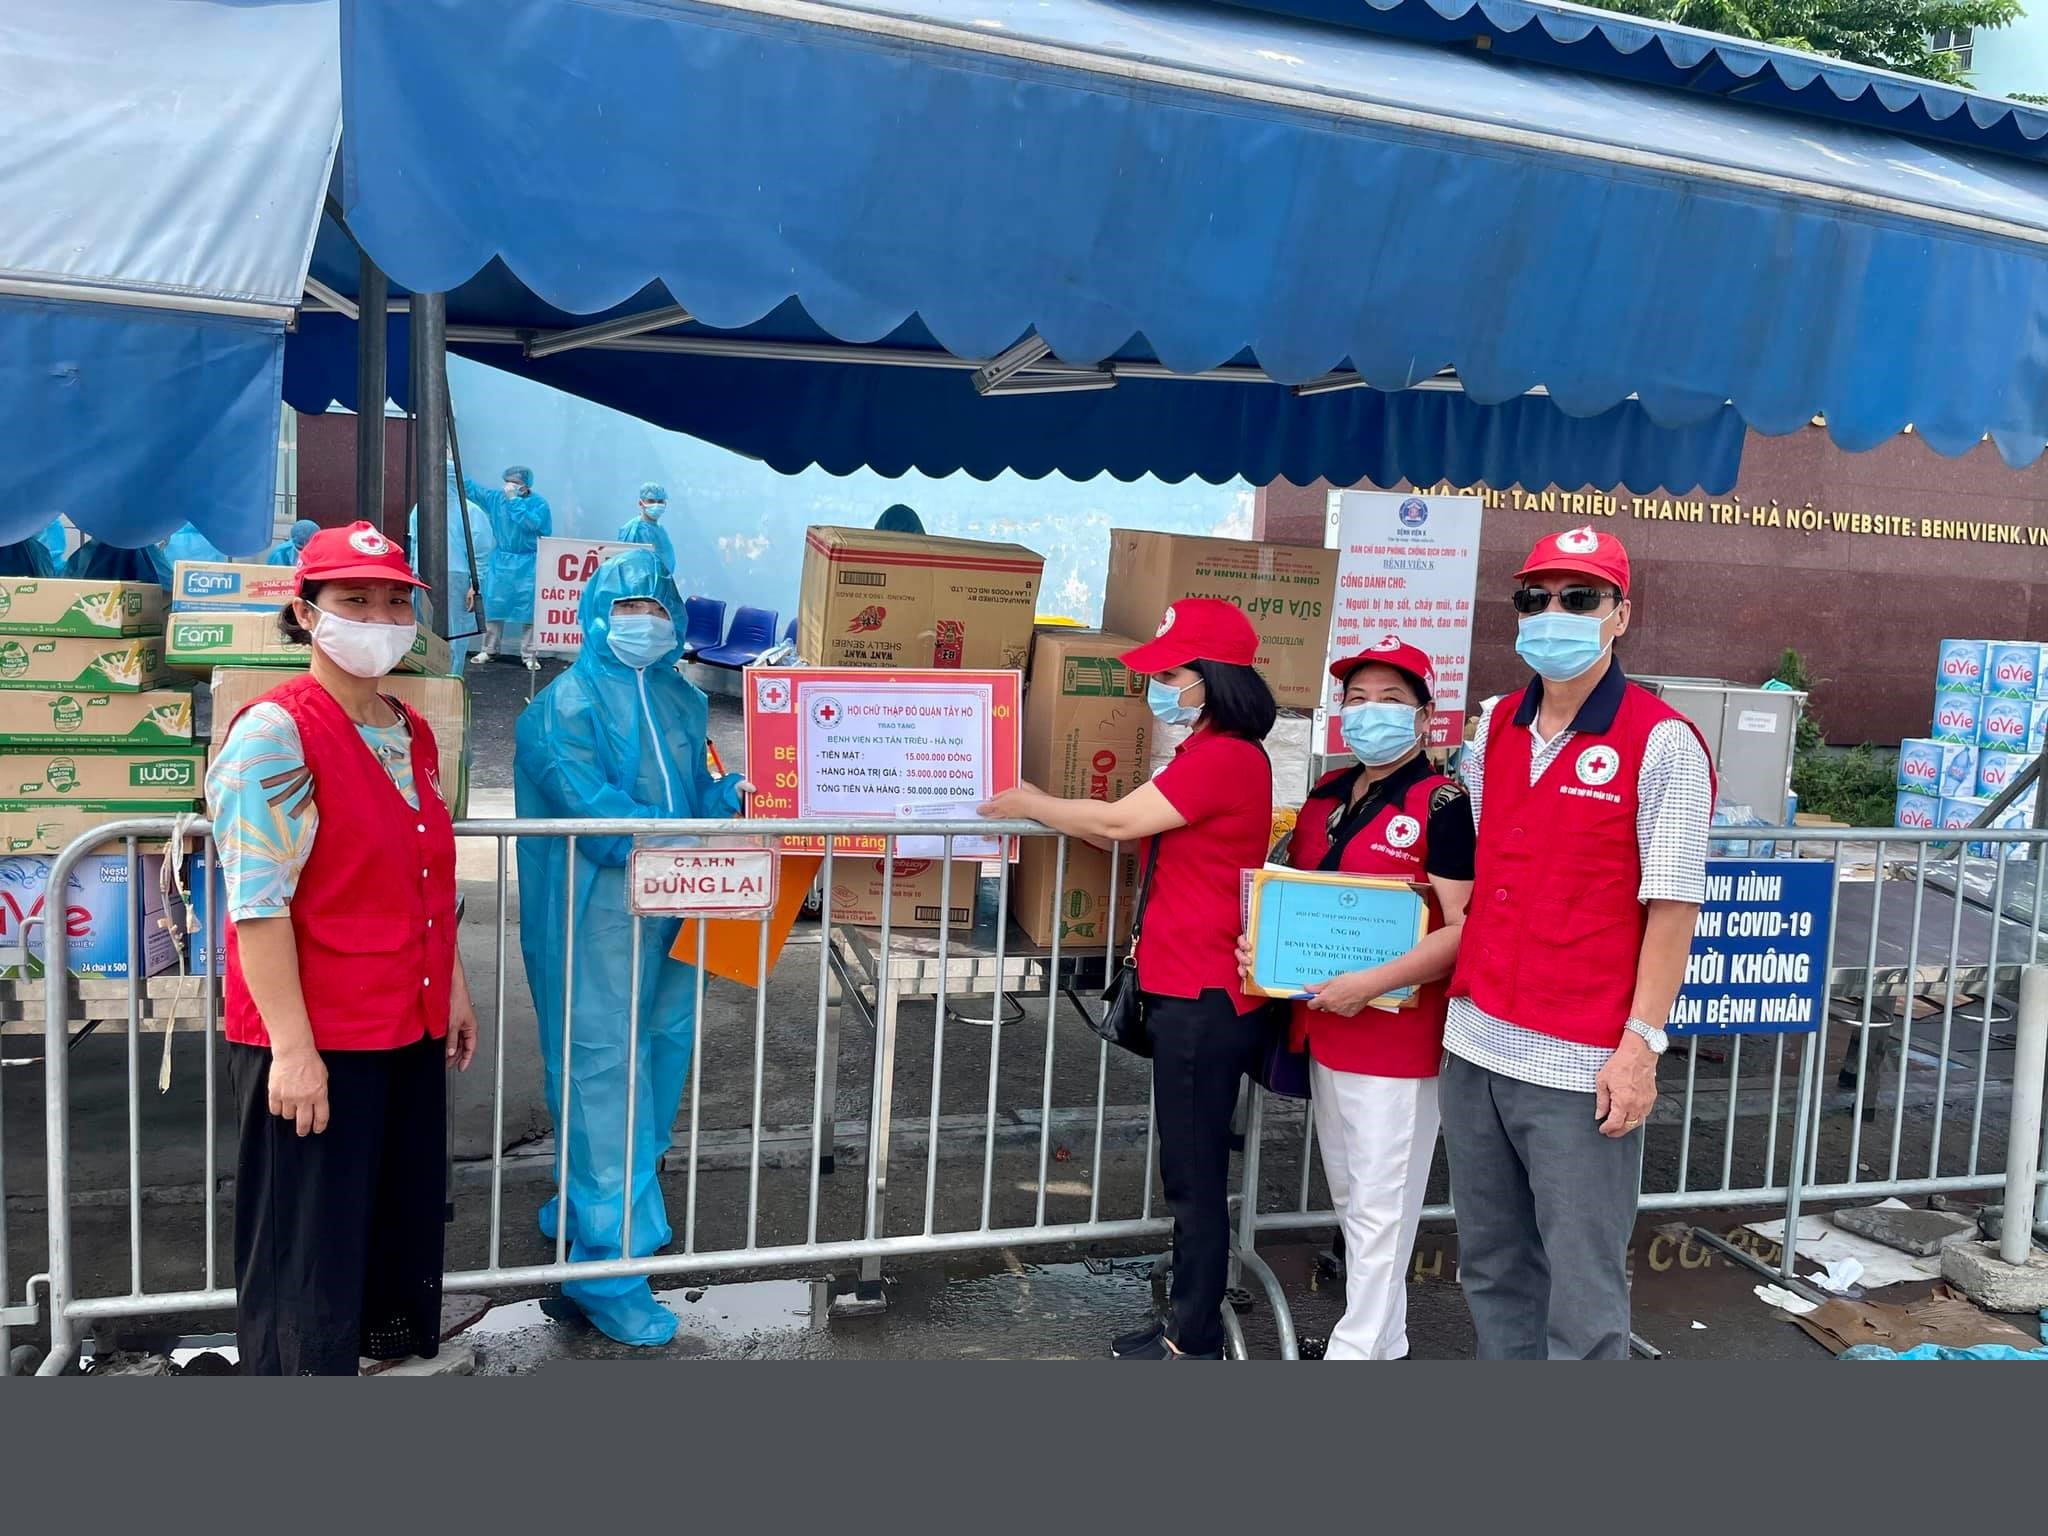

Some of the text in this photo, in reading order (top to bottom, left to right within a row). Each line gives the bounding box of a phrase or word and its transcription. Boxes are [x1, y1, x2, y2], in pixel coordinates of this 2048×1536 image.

[1631, 497, 1703, 523] THANH
[1921, 518, 2048, 546] BENHVIENK.VN
[1429, 561, 1435, 570] K
[188, 572, 232, 589] Fami
[1388, 576, 1406, 589] CHO:
[1247, 597, 1283, 621] BẮP
[1289, 600, 1322, 621] SỮA
[1345, 598, 1369, 611] Người
[1384, 600, 1393, 610] ho
[1456, 600, 1469, 610] đau
[1437, 616, 1451, 628] đau
[177, 626, 224, 643] Fami
[540, 632, 558, 646] TẠI
[832, 639, 902, 650] SHELLY SENBEI
[844, 650, 893, 660] WANT WANT
[1943, 658, 1979, 676] laVie
[1996, 664, 2033, 682] laVie
[1938, 710, 1973, 729] laVie
[1986, 717, 2024, 735] laVie
[827, 735, 850, 744] BỆNH
[852, 735, 871, 744] VIỆN
[934, 737, 947, 745] HÀ
[949, 738, 963, 746] NỘI
[905, 752, 946, 761] 15.000.000
[821, 766, 846, 776] HÀNG
[868, 768, 881, 779] TRỊ
[882, 767, 898, 777] GIÁ
[906, 770, 947, 778] 35.000.000
[1903, 759, 1936, 778] laVie
[862, 784, 874, 793] VÀ
[876, 785, 901, 794] HÀNG
[907, 787, 948, 795] 50.000.000
[754, 792, 792, 808] Gồm:
[674, 857, 735, 868] C.A.H.N
[643, 871, 763, 897] DỪNG LẠI
[1736, 870, 1782, 901] HÌNH
[1727, 911, 1812, 937] COVID-19
[82, 963, 91, 972] 24
[91, 962, 106, 972] chai
[107, 964, 112, 972] x
[1730, 948, 1810, 984] KHÔNG
[1706, 993, 1756, 1029] BỆNH
[1760, 993, 1812, 1023] NHÂN
